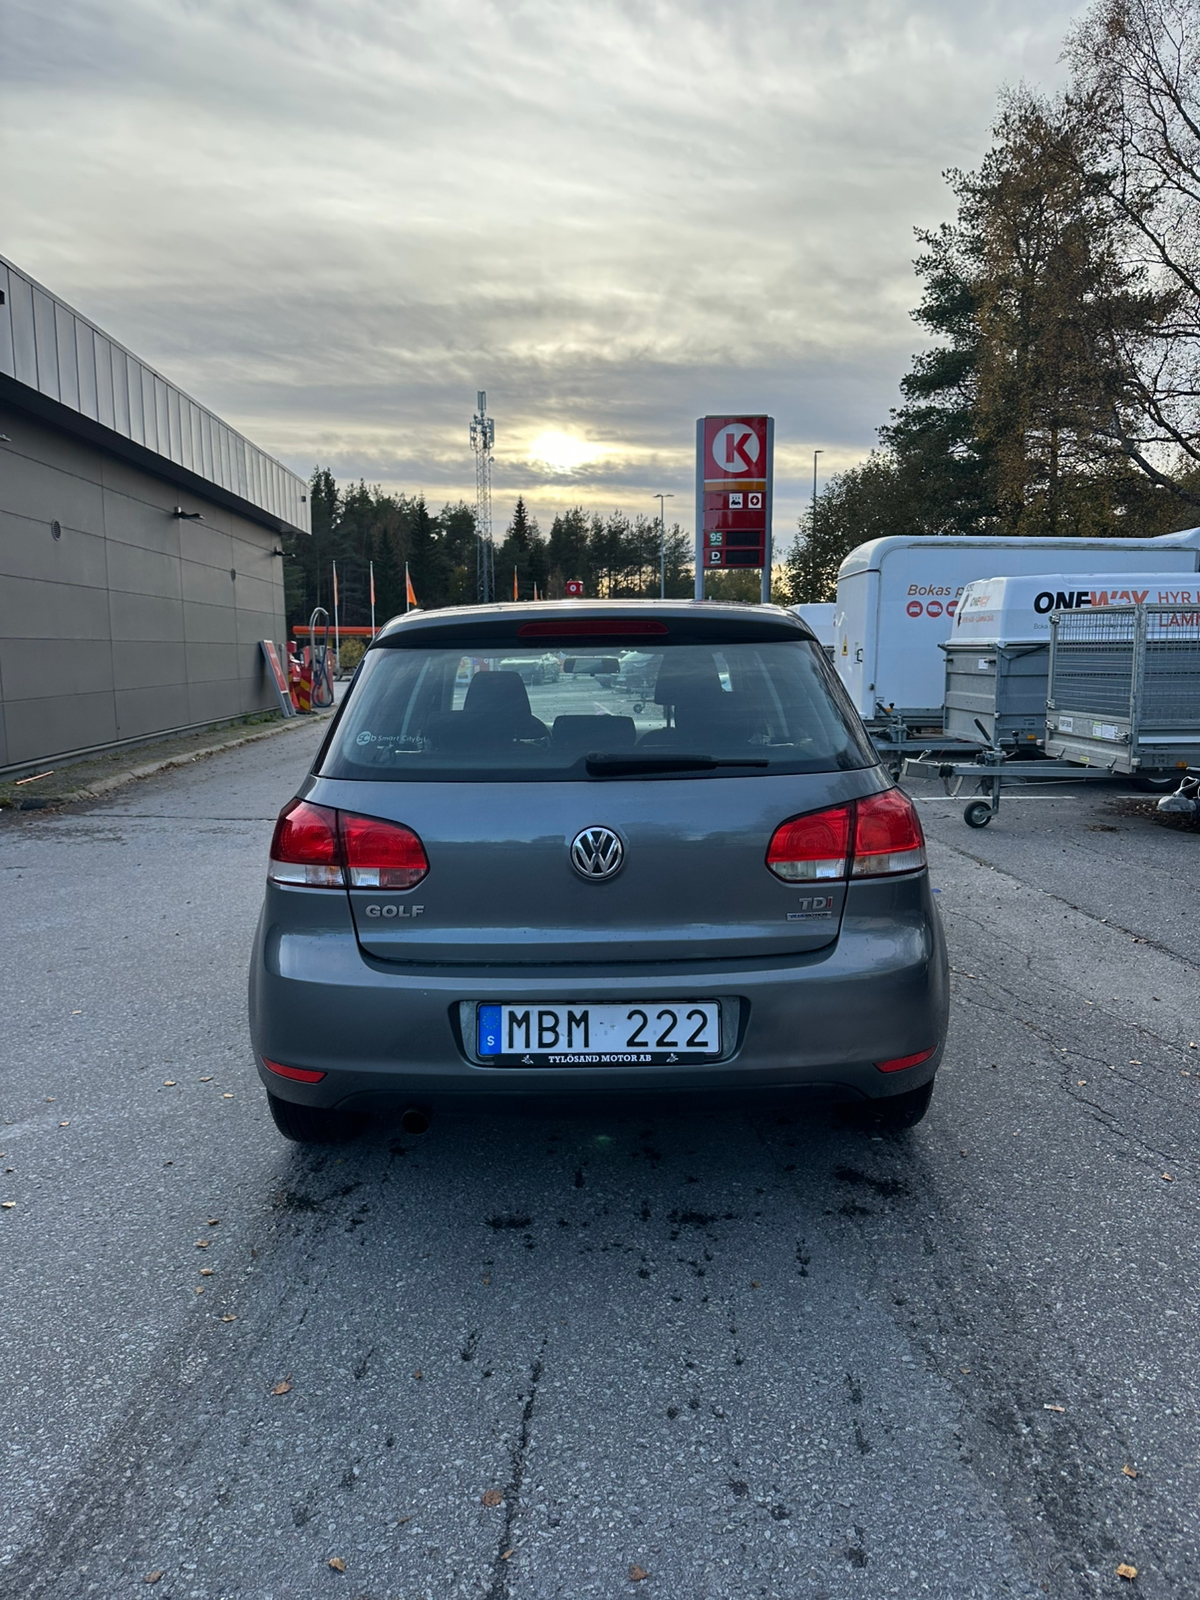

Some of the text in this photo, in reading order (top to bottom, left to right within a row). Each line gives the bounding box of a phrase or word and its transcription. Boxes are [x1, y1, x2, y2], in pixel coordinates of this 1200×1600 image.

[709, 532, 722, 542] 95
[711, 551, 721, 560] D
[907, 584, 952, 596] Bokas
[1033, 590, 1150, 615] ONEWAY
[1158, 591, 1192, 604] HYR
[378, 734, 400, 742] Smart
[798, 896, 834, 910] TDI
[365, 904, 425, 918] GOLF
[507, 1009, 709, 1049] MBM 222
[487, 1035, 495, 1047] S
[548, 1053, 652, 1063] TYLÖSAND MOTOR AB
